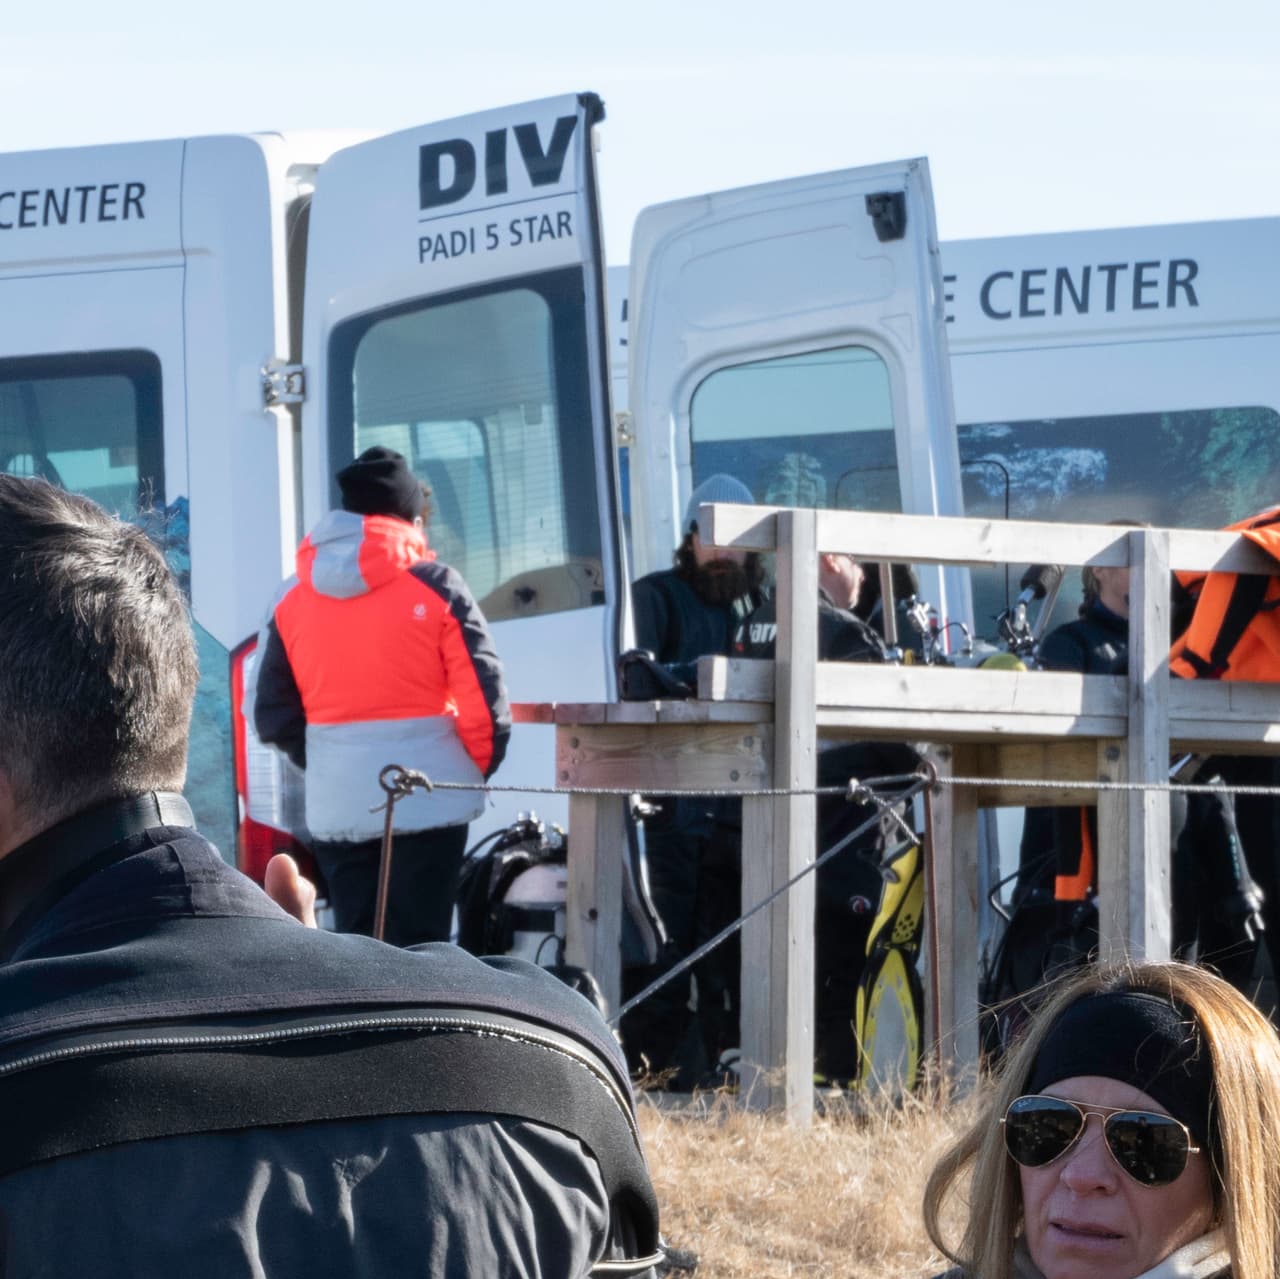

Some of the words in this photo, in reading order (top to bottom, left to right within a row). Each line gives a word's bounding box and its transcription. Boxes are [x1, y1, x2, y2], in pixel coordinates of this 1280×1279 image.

[420, 115, 578, 209] DIV
[419, 228, 475, 263] PADI
[486, 224, 500, 251] 5
[509, 210, 573, 246] STAR
[979, 257, 1200, 321] CENTER
